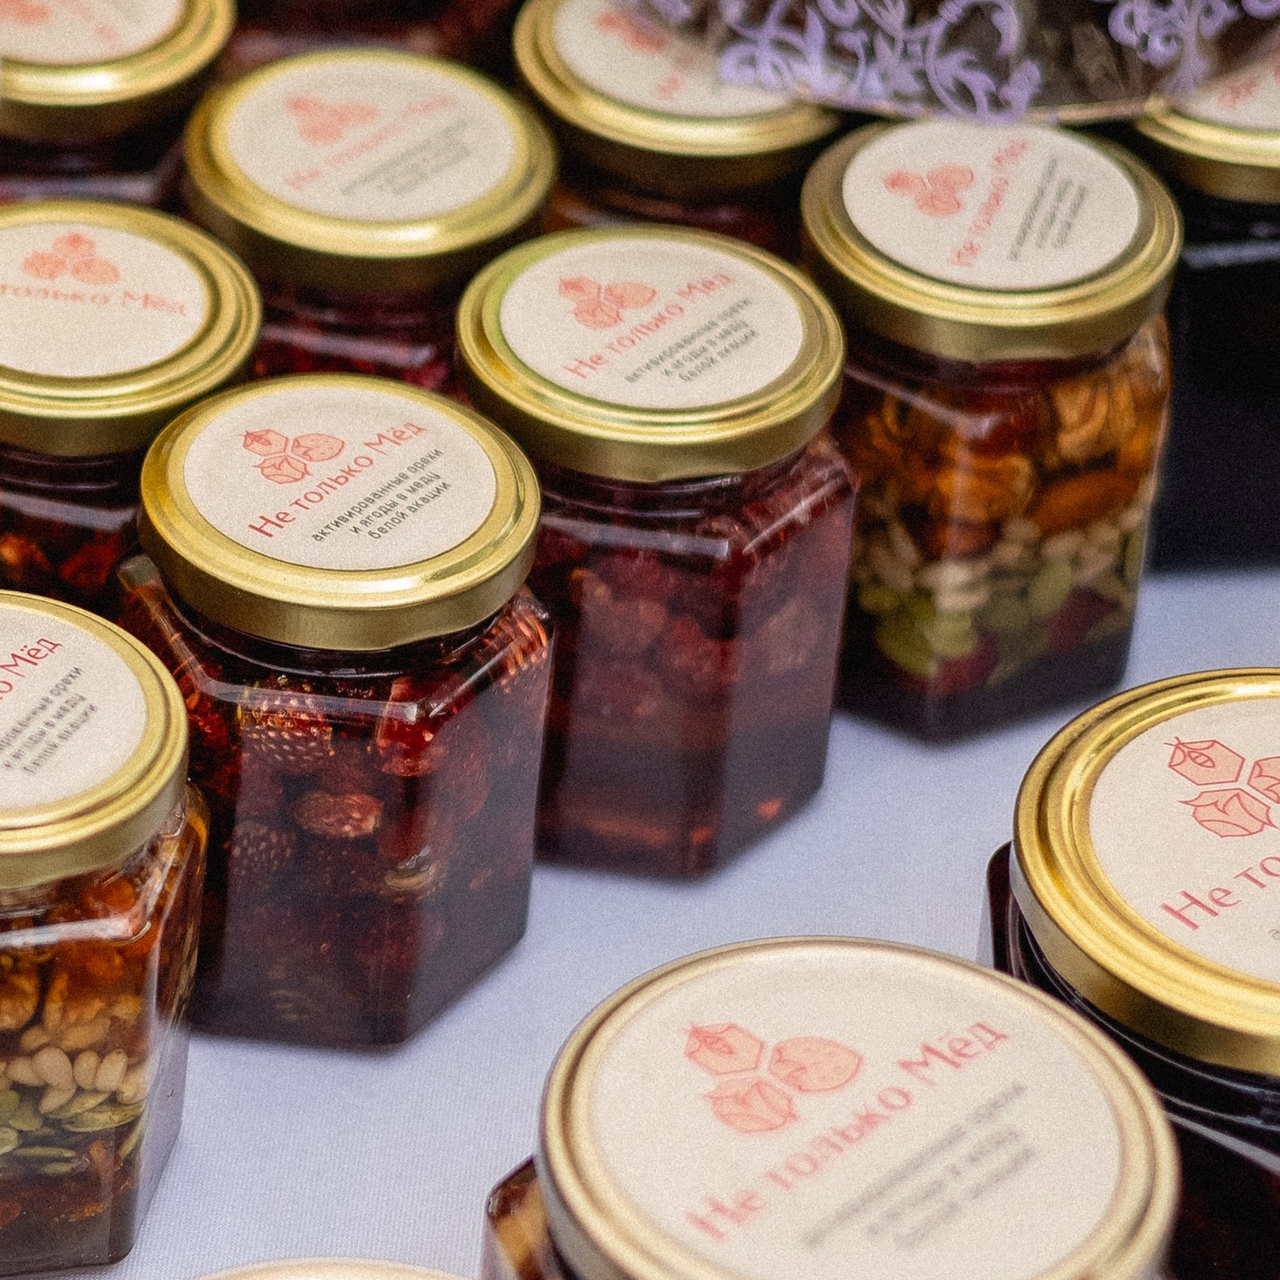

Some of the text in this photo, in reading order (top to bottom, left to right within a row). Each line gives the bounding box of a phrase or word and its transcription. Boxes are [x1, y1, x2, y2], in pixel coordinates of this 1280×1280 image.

[563, 354, 609, 380] Не
[605, 302, 686, 355] только
[248, 420, 429, 539] Не только Мёд
[311, 447, 444, 543] активированные орехи
[349, 524, 360, 535] и
[359, 498, 399, 527] ягоды
[408, 471, 442, 495] меду
[367, 480, 453, 541] белой акации
[1158, 886, 1243, 932] Не
[685, 1021, 1011, 1240] Не только Мёд
